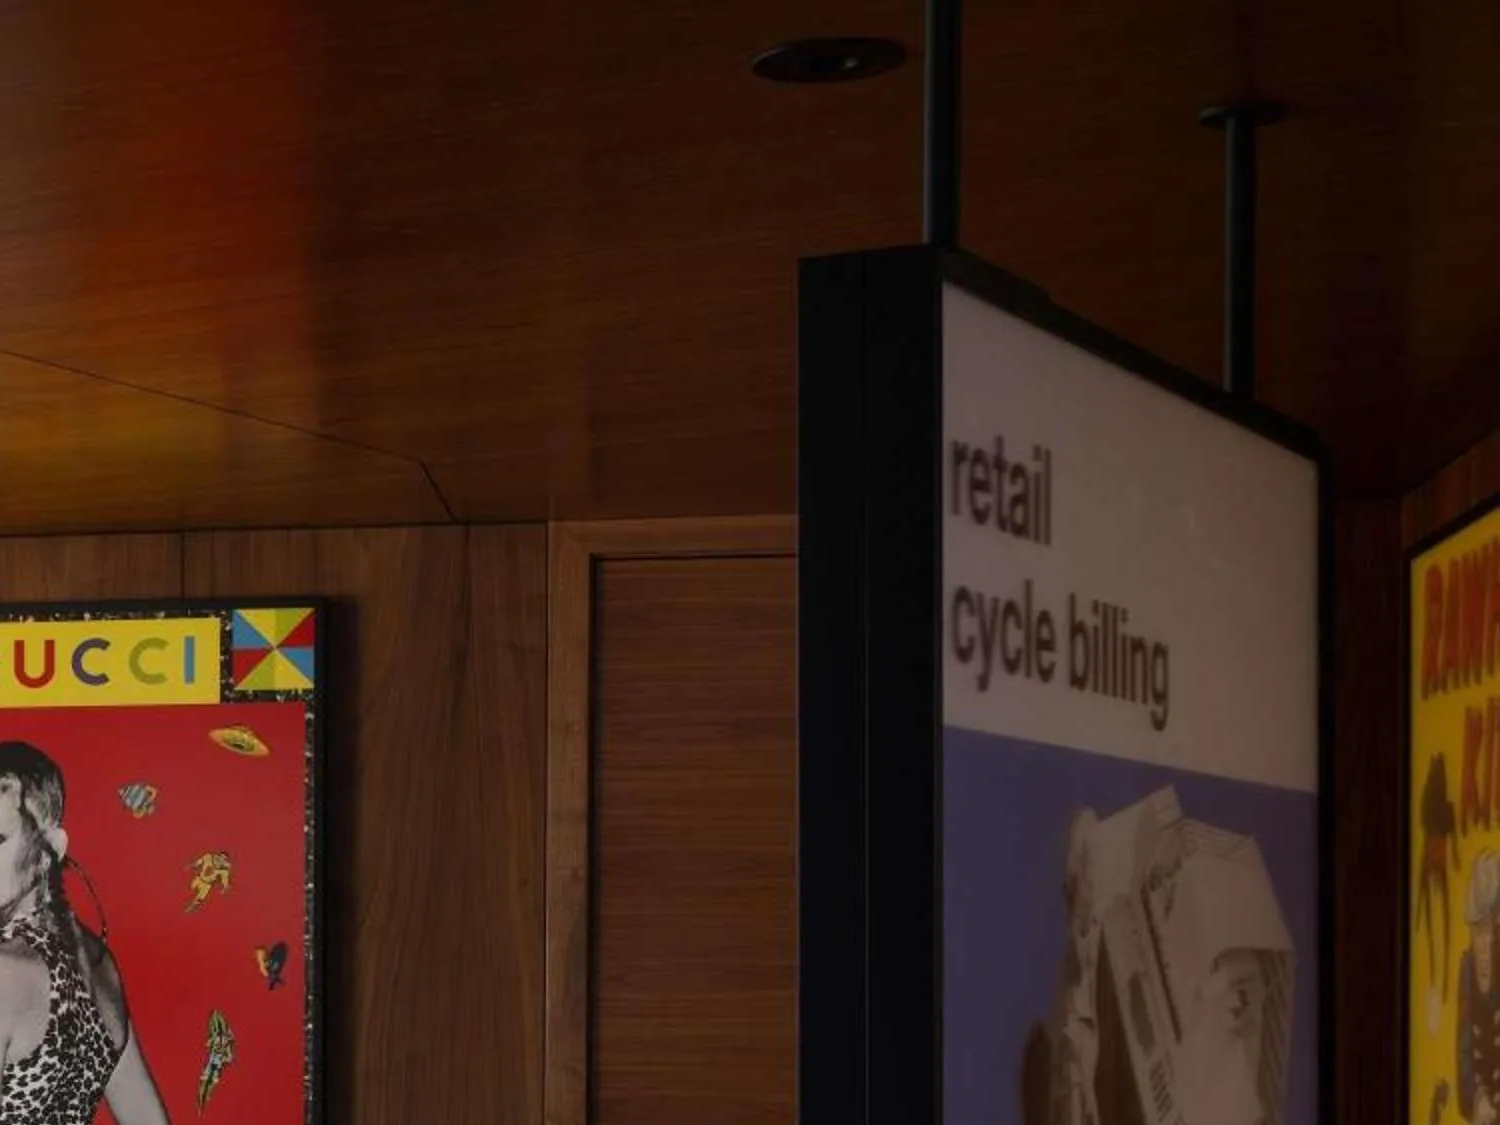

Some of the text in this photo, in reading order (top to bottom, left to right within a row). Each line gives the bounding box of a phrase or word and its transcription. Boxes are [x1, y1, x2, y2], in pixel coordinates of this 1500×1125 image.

[951, 435, 1052, 546] retail
[951, 578, 1170, 732] cycle billing
